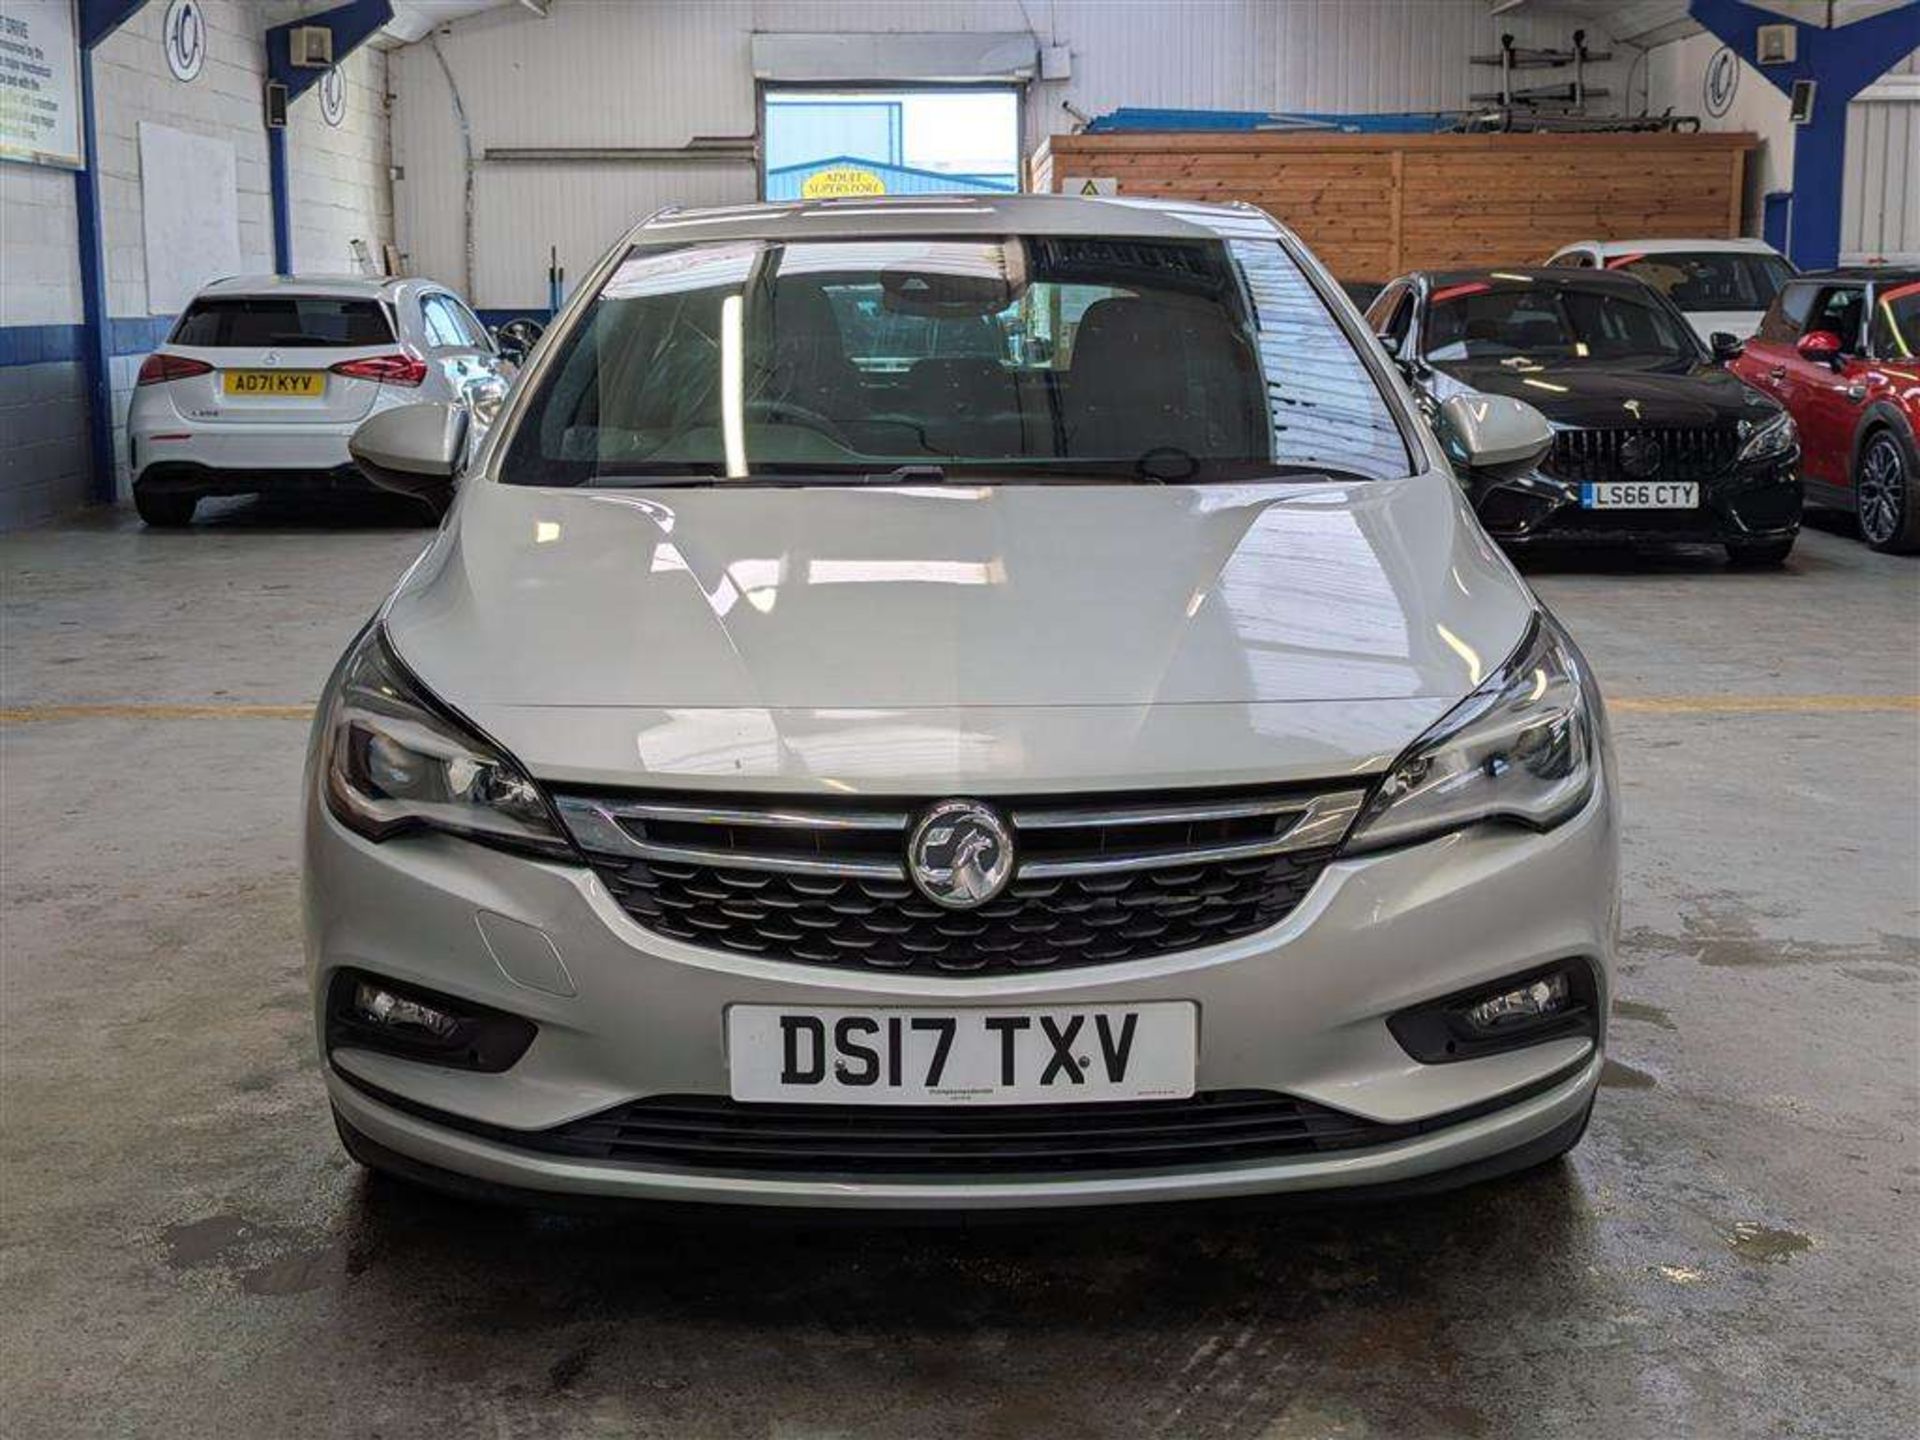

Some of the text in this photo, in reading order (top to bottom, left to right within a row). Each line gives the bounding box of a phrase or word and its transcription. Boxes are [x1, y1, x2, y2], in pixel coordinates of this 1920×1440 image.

[809, 182, 879, 193] SUPERSTORE
[277, 374, 312, 391] KYV
[1597, 485, 1649, 505] LS66
[1655, 485, 1694, 504] CTY
[780, 1013, 1139, 1087] DS17 TXV
